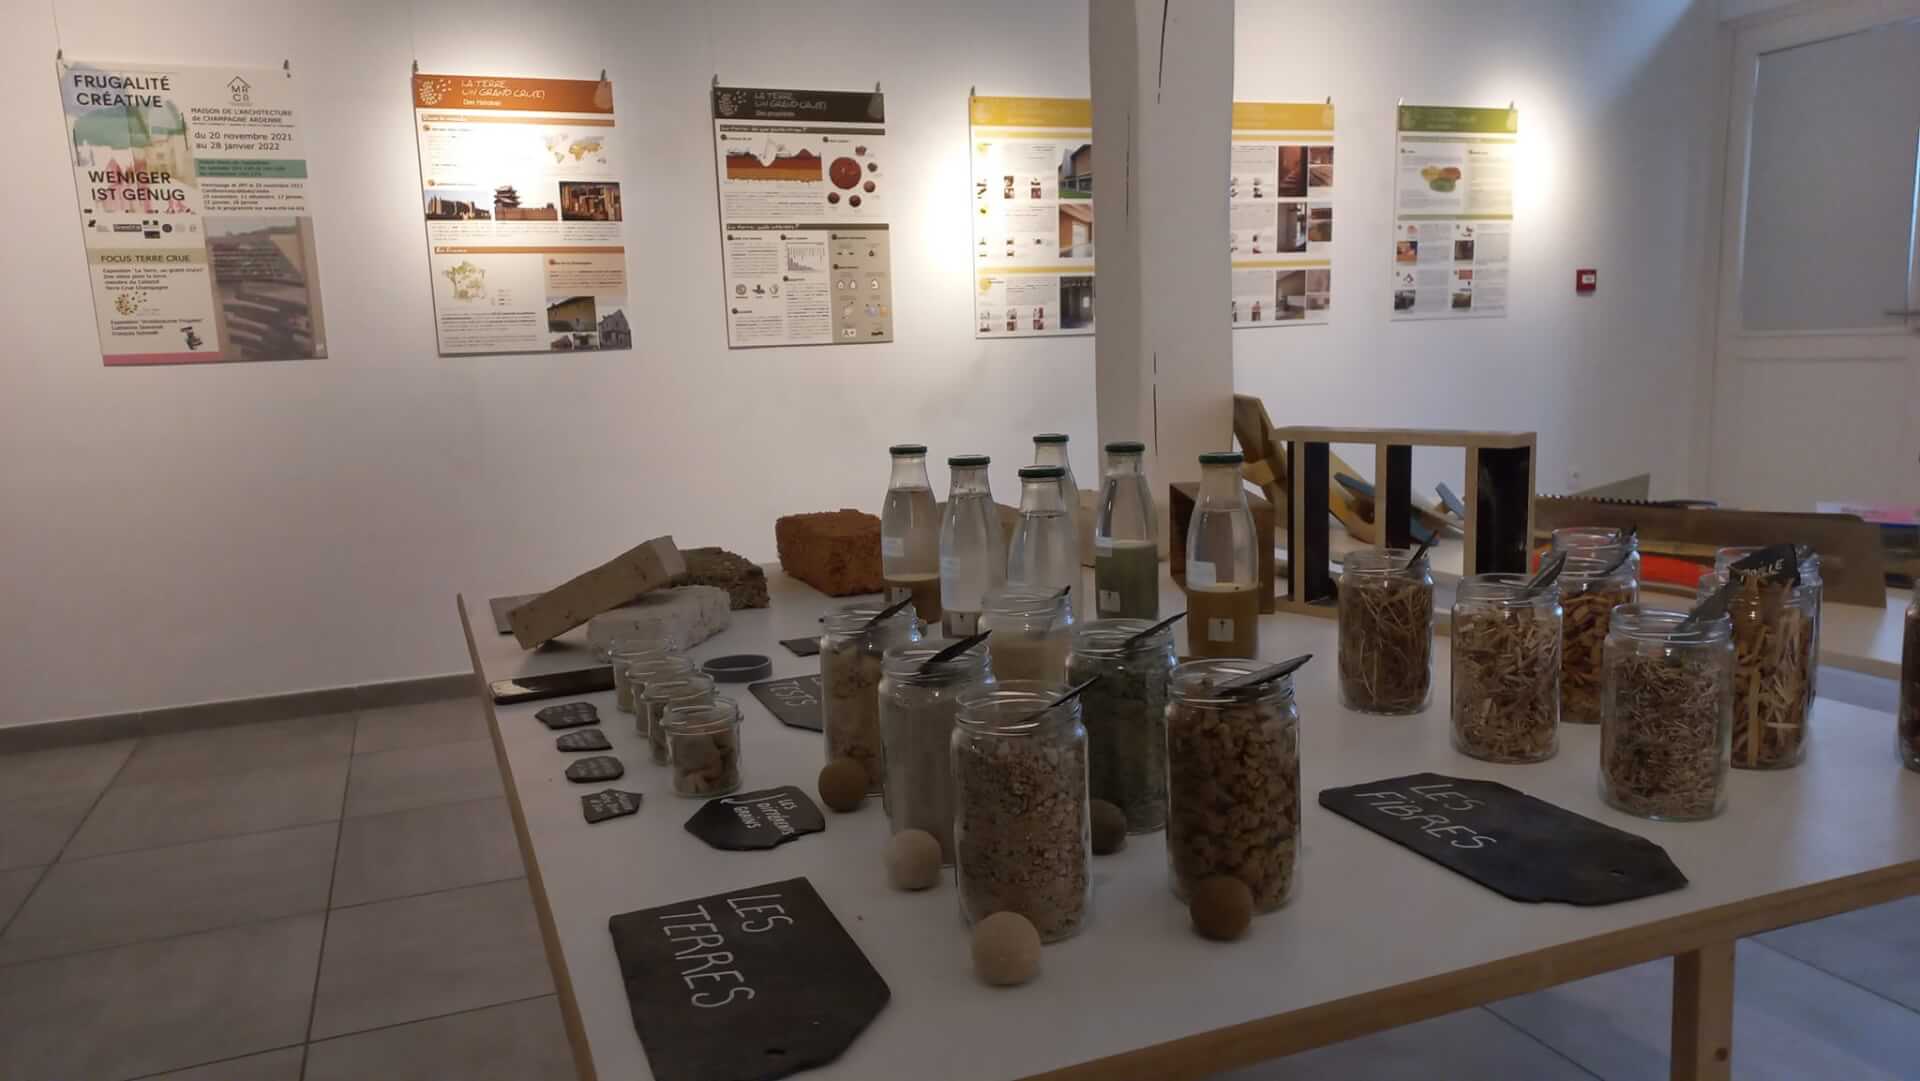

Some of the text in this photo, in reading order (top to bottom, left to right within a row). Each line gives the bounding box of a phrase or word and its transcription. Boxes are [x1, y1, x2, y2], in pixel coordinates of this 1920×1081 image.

[73, 75, 171, 91] FRUGALITÉ
[476, 80, 506, 88] TERRE
[478, 88, 512, 96] GRAND
[76, 91, 163, 108] CRÉATIVE
[223, 132, 268, 140] novembre
[271, 133, 292, 141] 2021
[224, 142, 255, 151] janvier
[88, 171, 171, 184] WENIGER
[91, 188, 185, 200] IST GENUG
[166, 254, 191, 262] CRUE
[778, 798, 798, 810] LES
[1409, 784, 1486, 812] LES
[1353, 791, 1497, 850] FIBRES
[727, 893, 793, 933] LES
[659, 904, 756, 1008] TERRES
